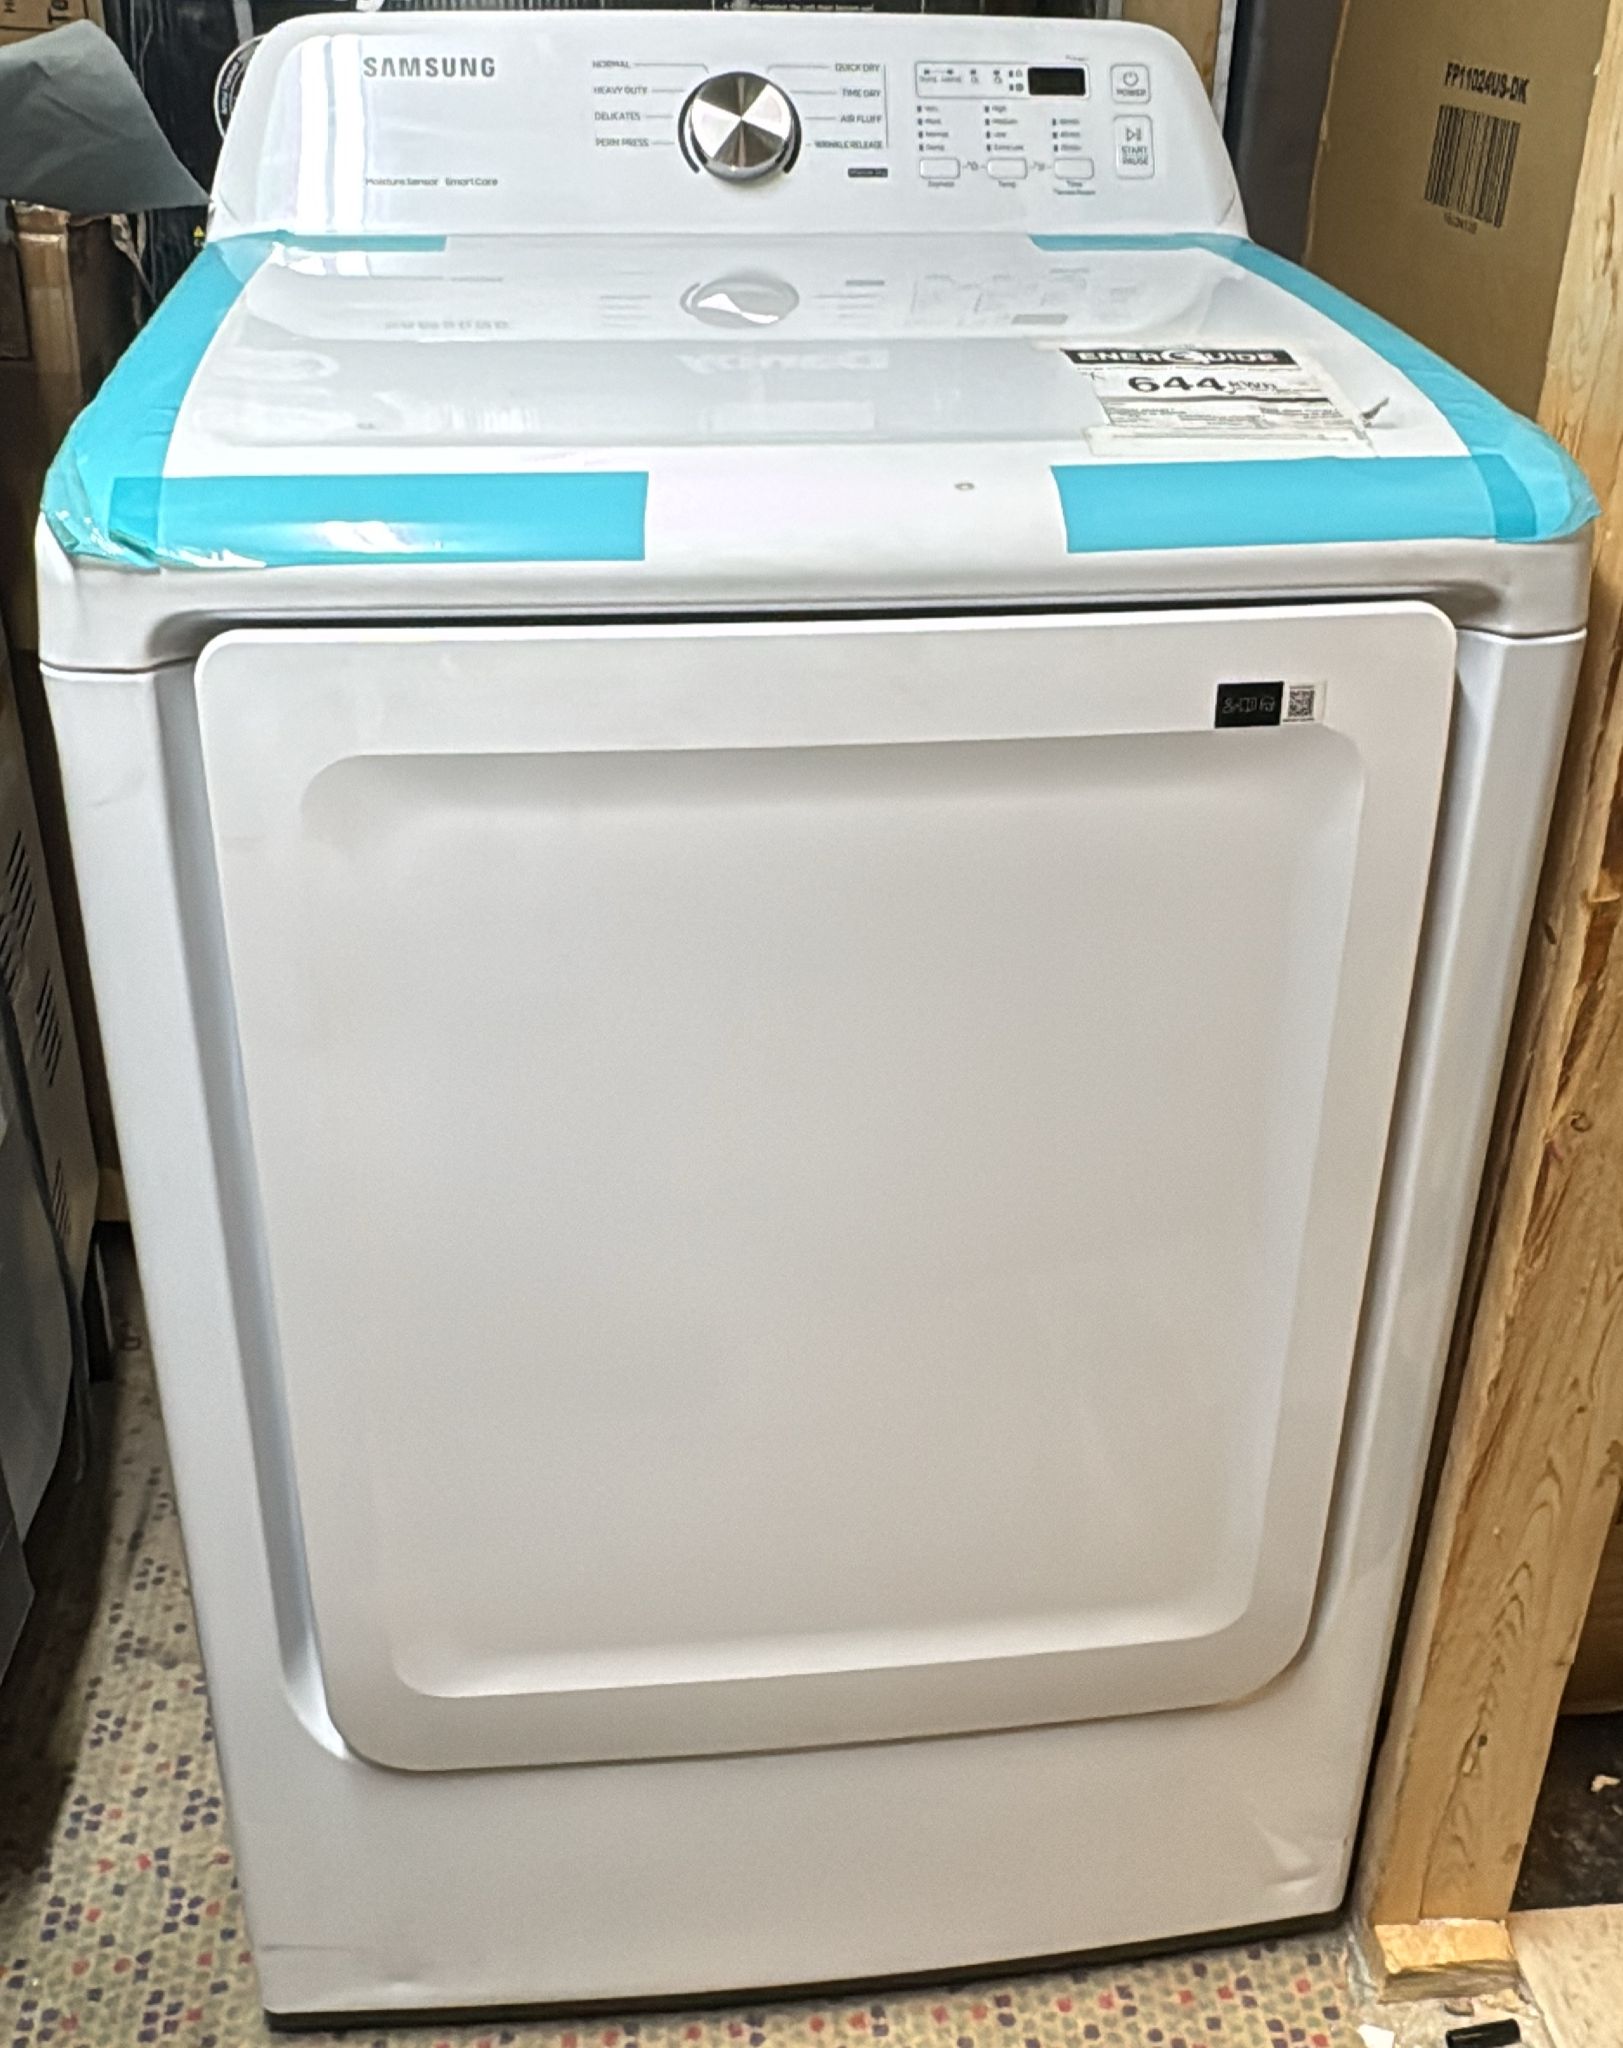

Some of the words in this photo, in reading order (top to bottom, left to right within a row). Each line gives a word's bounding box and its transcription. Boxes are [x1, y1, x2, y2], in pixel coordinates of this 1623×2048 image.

[363, 56, 496, 78] SAMSUNG
[592, 60, 631, 69] NORMAL
[835, 63, 861, 72] QUICK
[862, 63, 881, 72] DRY
[593, 86, 623, 95] HEAVY
[624, 86, 648, 95] DUTY
[842, 88, 862, 97] TIME
[863, 88, 881, 97] DRY
[1116, 88, 1147, 97] POWER
[594, 112, 642, 121] DELICATES
[840, 114, 855, 123] AIR
[857, 114, 883, 123] FLUFF
[595, 137, 620, 147] PERM
[622, 138, 649, 147] PRESS
[814, 140, 849, 149] WRINKLE
[849, 141, 882, 150] RELEASE
[1121, 145, 1148, 155] START
[1121, 155, 1149, 166] PAUSE
[1128, 376, 1226, 392] 644
